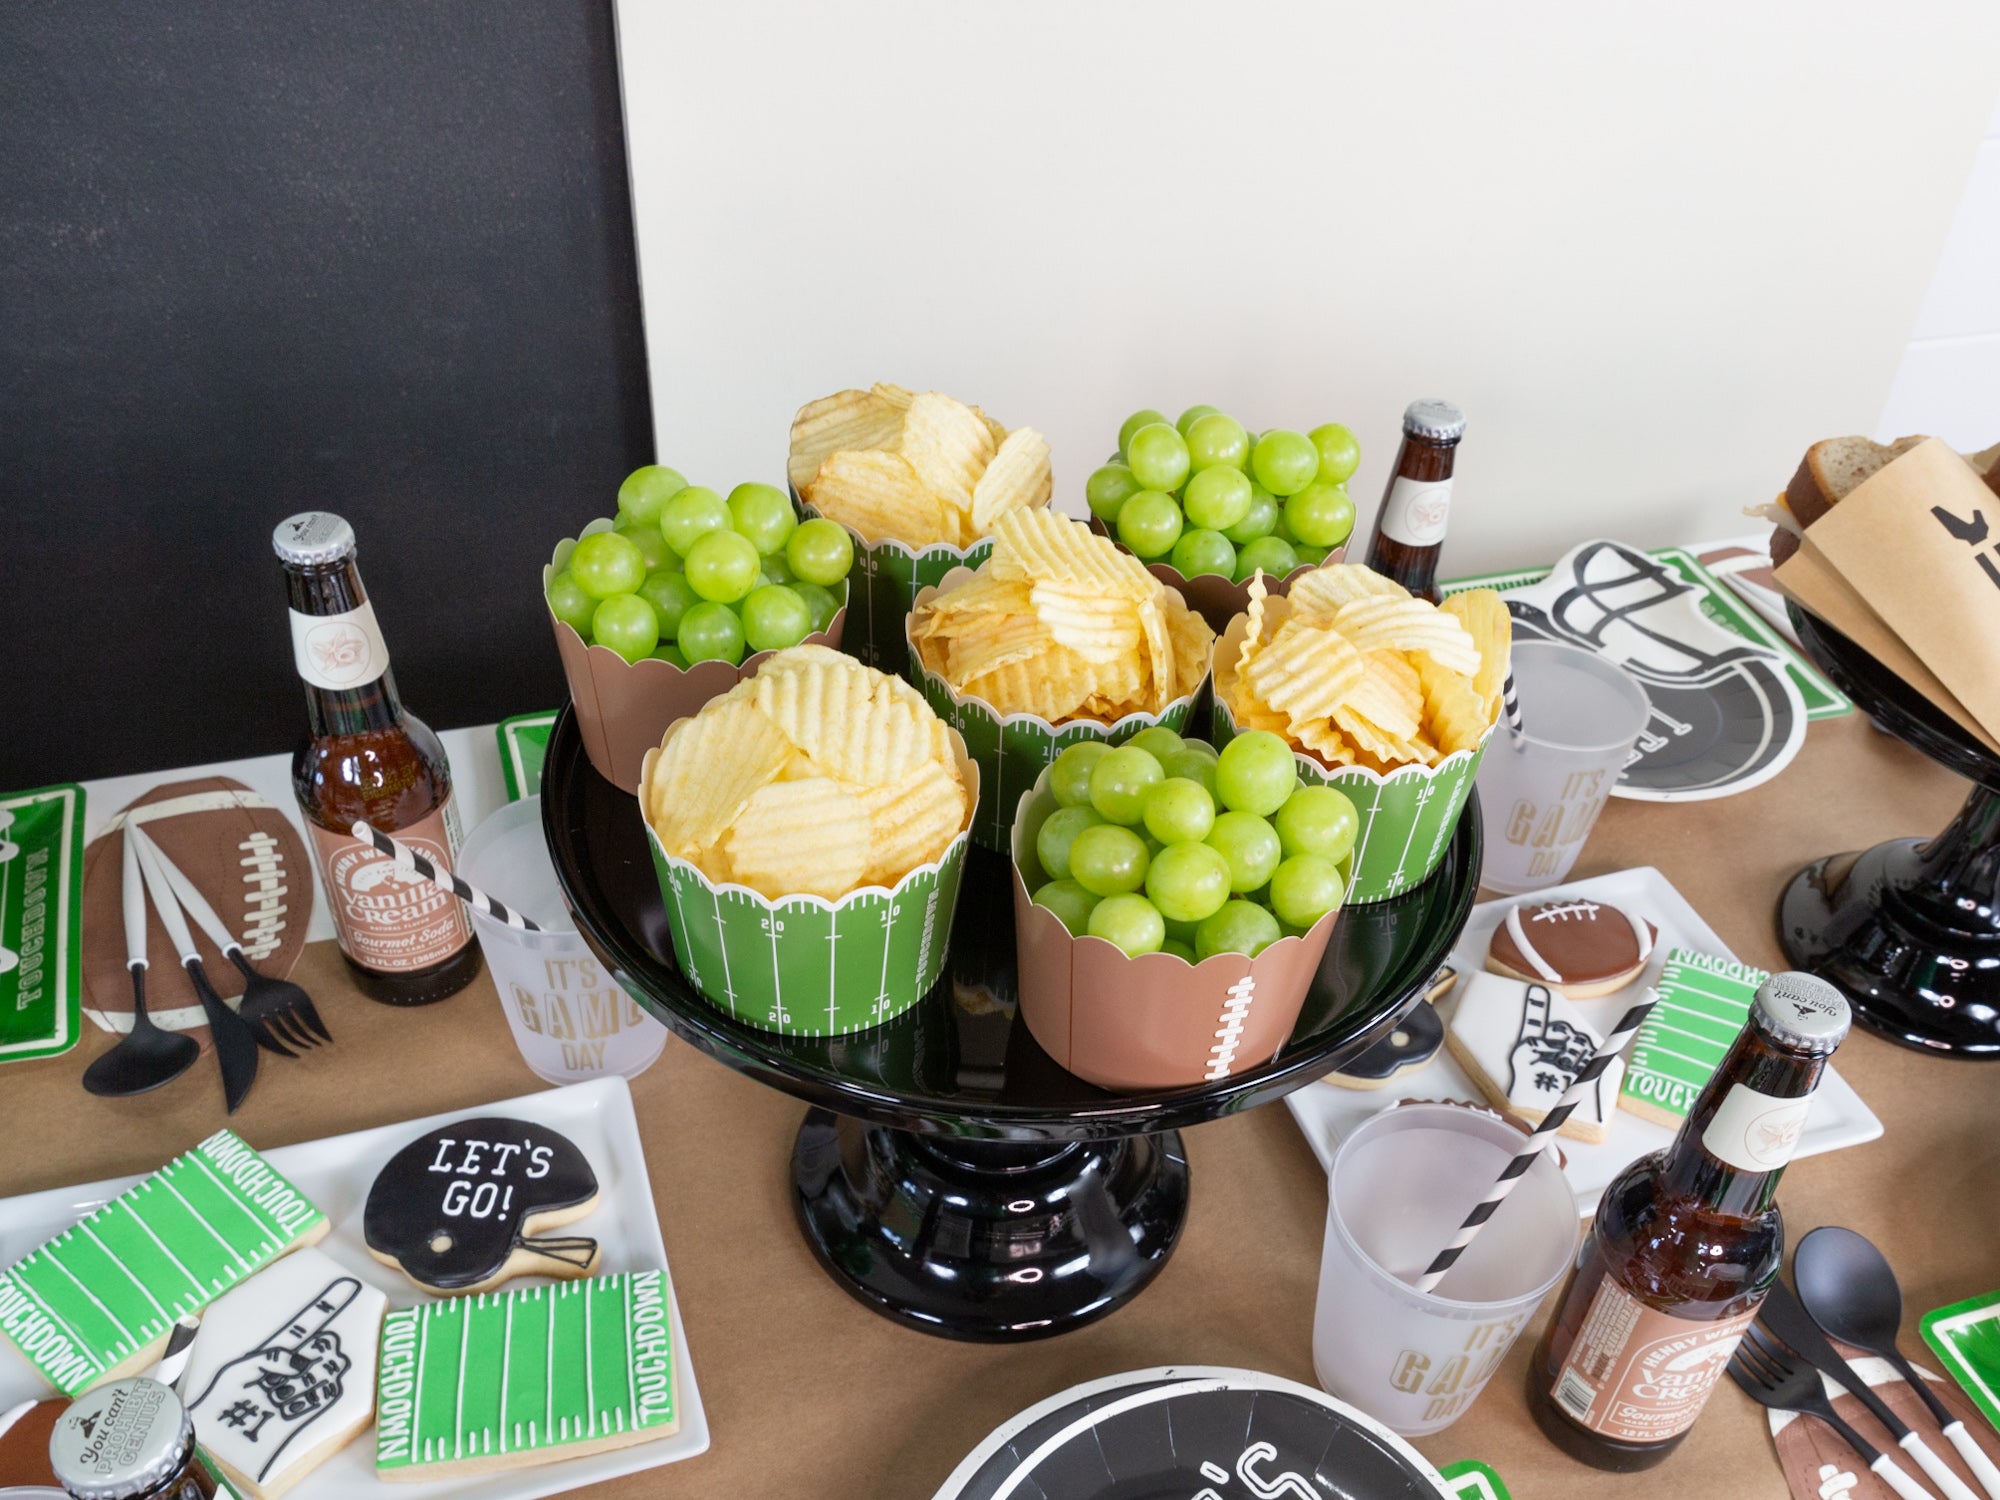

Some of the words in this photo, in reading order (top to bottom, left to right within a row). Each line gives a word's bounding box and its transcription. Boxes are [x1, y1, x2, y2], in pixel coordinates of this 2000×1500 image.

[340, 881, 444, 908] Vanilla
[880, 904, 901, 921] 10
[16, 847, 49, 1011] TOUCHDOWN
[353, 930, 417, 949] Gourmet
[420, 919, 454, 943] Soda
[761, 918, 785, 932] 20
[544, 957, 599, 990] IT'S
[768, 1012, 791, 1024] 20
[871, 1000, 891, 1015] 10
[561, 1040, 606, 1071] DAY
[428, 1138, 554, 1179] LET'S
[197, 1128, 316, 1238] TOUCHDOWN
[440, 1180, 514, 1221] GO!
[631, 1268, 671, 1425] TOUCHDOWN
[1643, 1336, 1698, 1369] HENRY
[377, 1304, 420, 1461] TOUCHDOWN
[80, 1428, 110, 1464] You
[104, 1388, 129, 1427] can't
[94, 1380, 153, 1474] PROHIBIT
[118, 1390, 166, 1466] GENIUS
[217, 1399, 275, 1443] #1
[1621, 1428, 1636, 1438] 12
